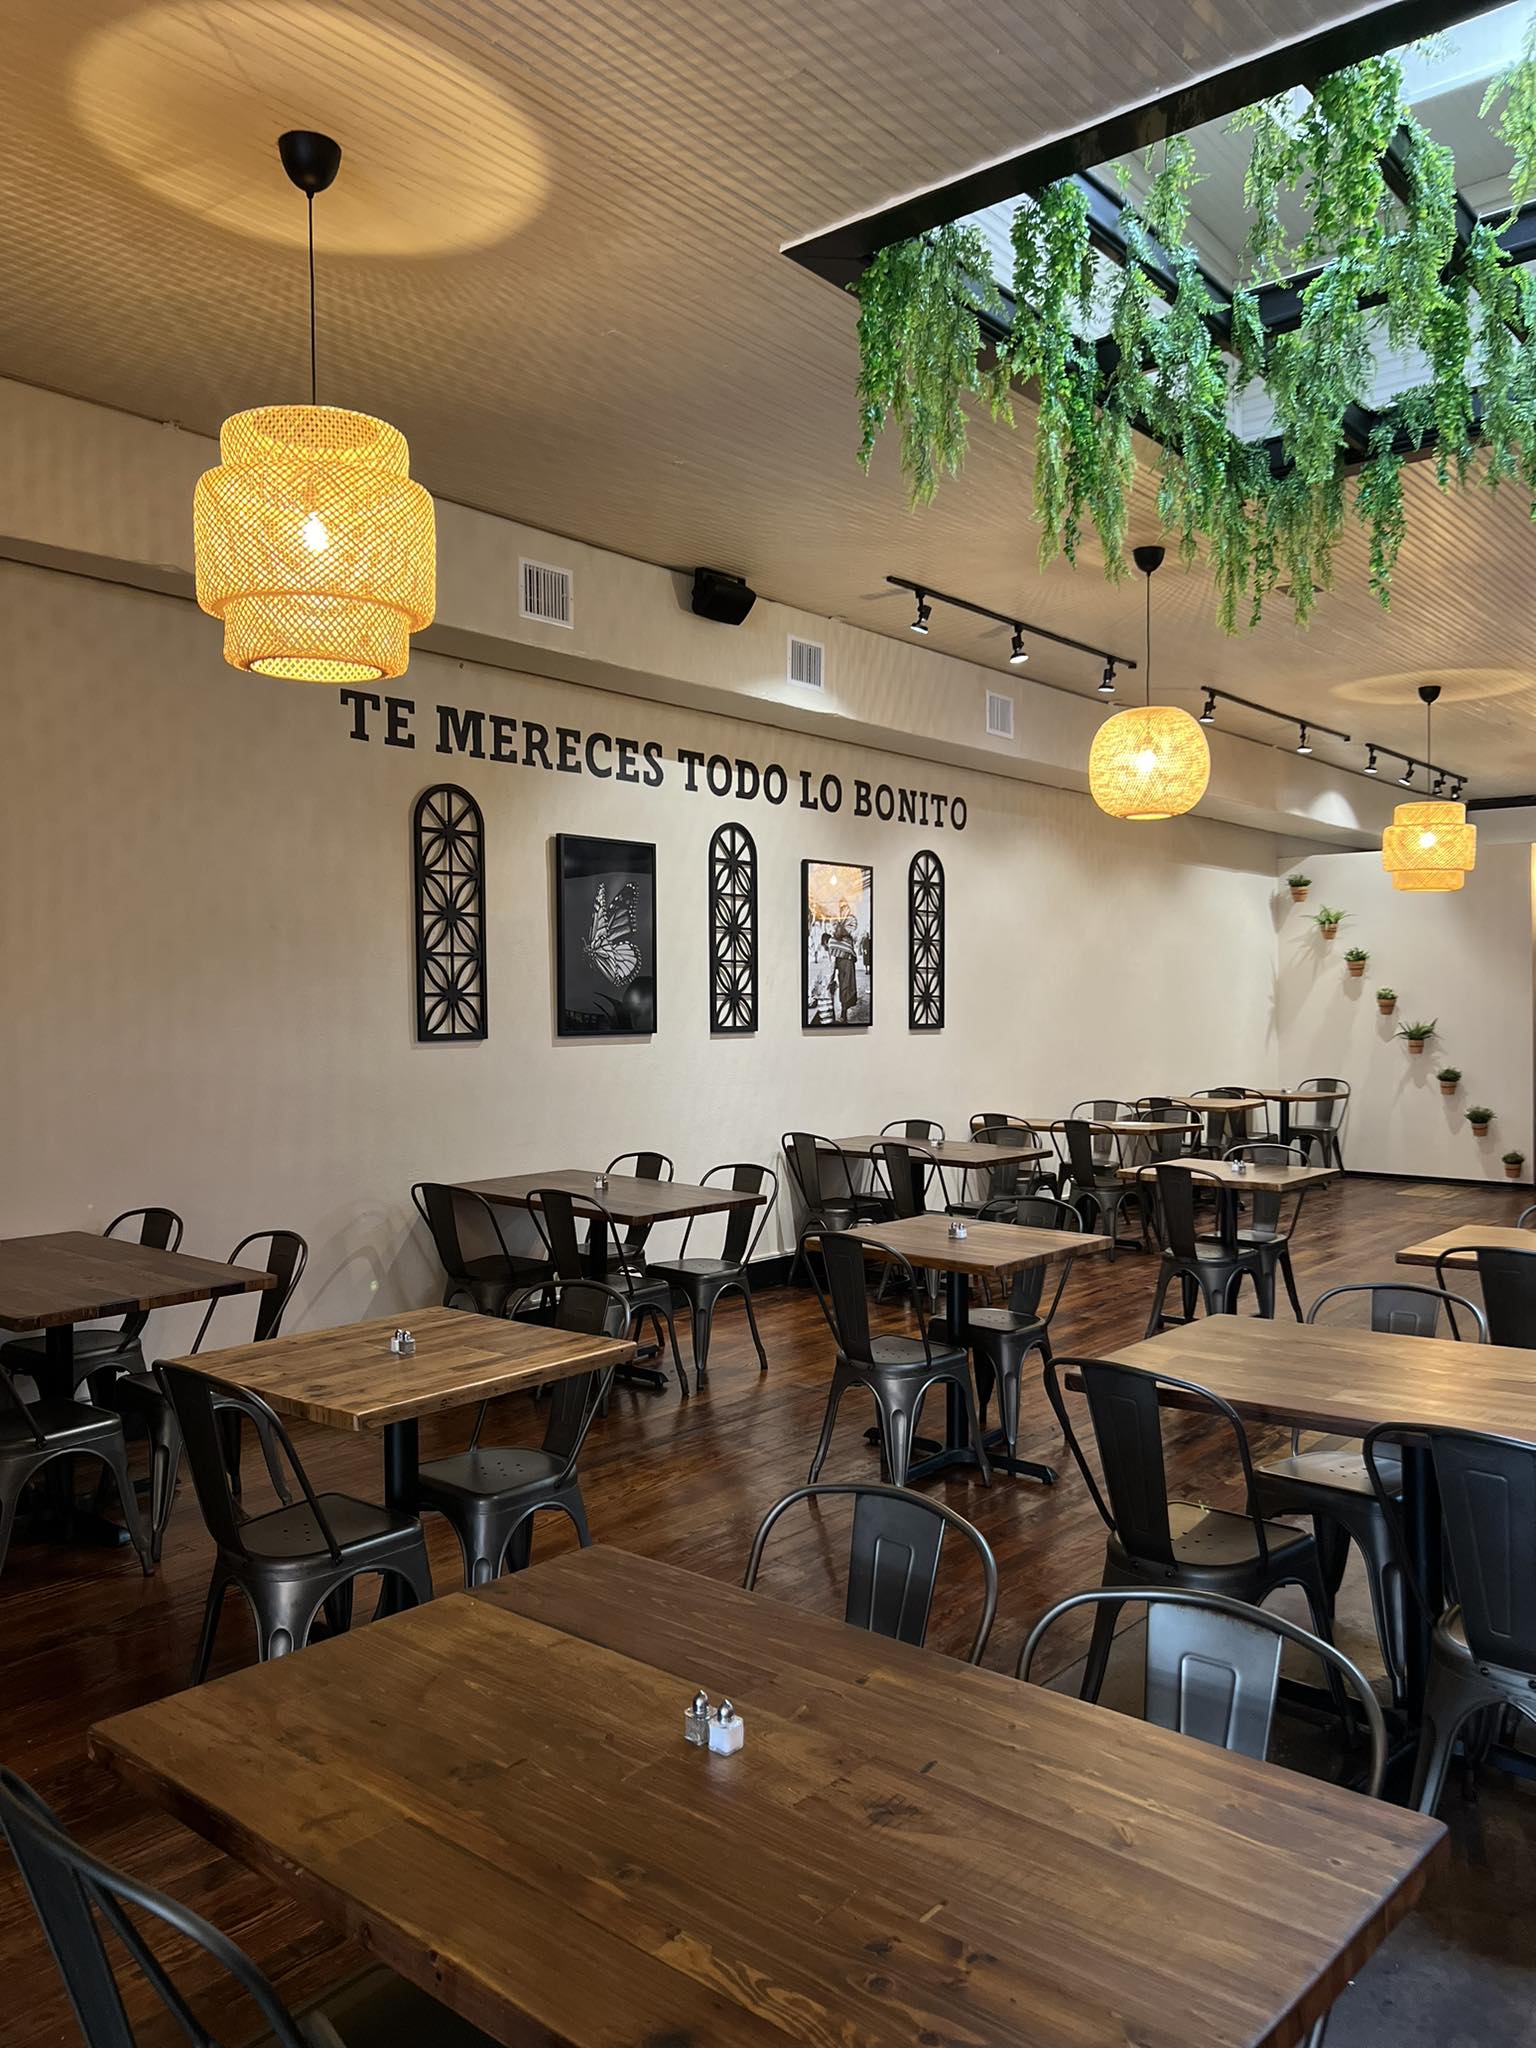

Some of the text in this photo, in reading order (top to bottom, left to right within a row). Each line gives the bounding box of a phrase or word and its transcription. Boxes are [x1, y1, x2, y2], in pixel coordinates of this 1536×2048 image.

[340, 688, 968, 831] TE MERECES TODO LO BONITO
